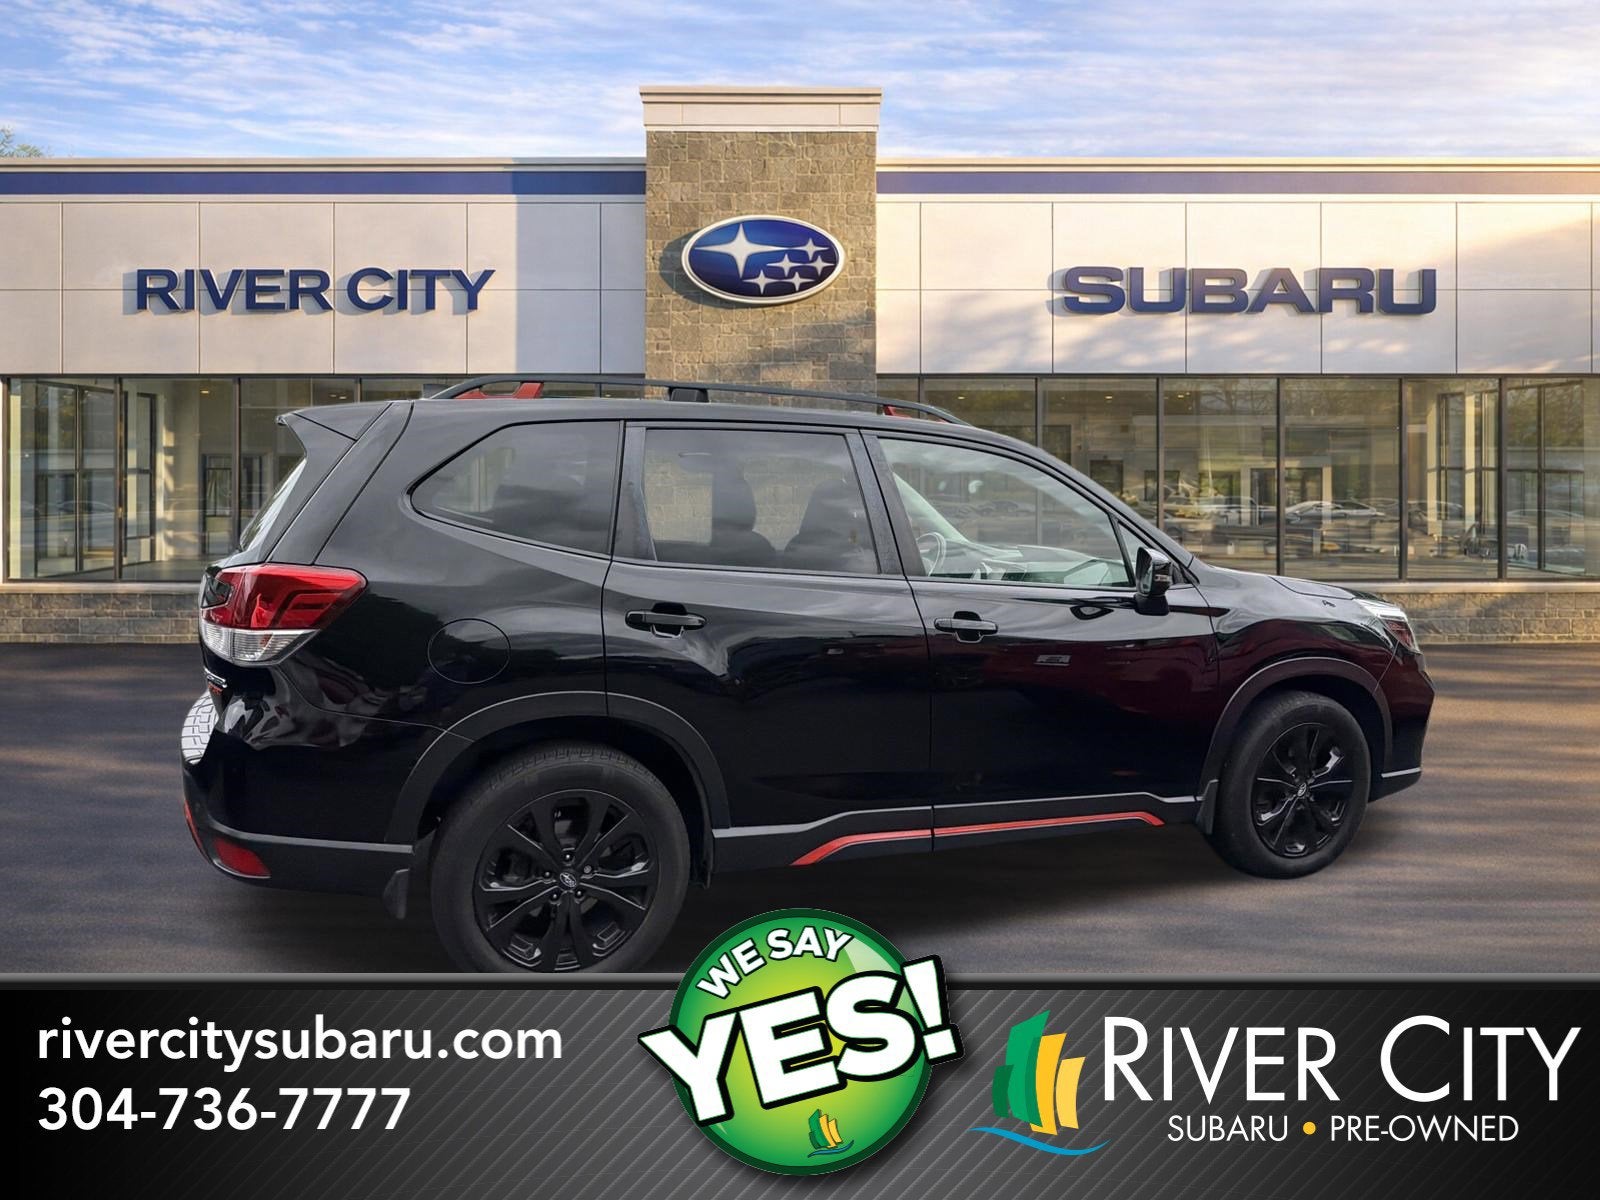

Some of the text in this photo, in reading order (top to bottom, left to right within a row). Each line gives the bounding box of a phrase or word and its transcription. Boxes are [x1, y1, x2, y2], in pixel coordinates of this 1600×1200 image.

[136, 267, 496, 312] RIVER CITY
[1063, 266, 1437, 314] SUBARU
